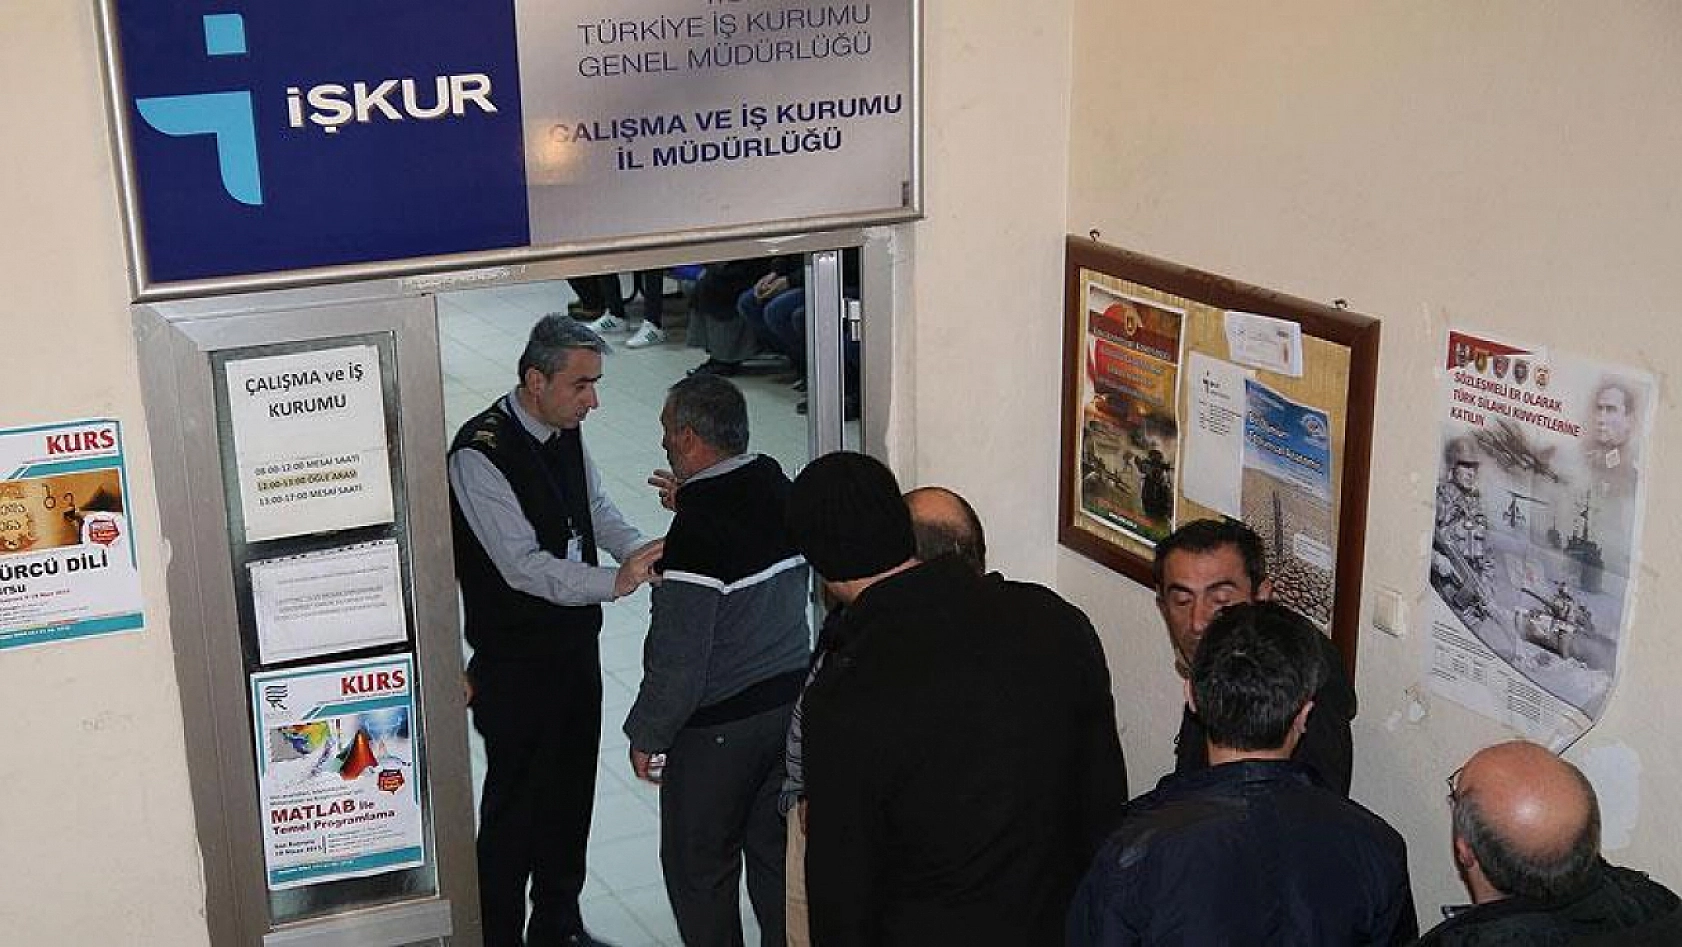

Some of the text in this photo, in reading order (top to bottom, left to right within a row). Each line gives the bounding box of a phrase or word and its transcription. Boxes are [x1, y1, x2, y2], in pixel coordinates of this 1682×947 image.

[577, 4, 871, 46] TÜRKİYE İŞ KURUMU
[578, 32, 871, 77] GENEL MÜDÜRLÜĞÜ
[286, 73, 498, 133] İŞKUR
[695, 108, 732, 132] VE
[742, 102, 768, 131] İŞ
[777, 94, 902, 123] KURUMU
[618, 129, 842, 171] İL MÜDÜRLÜĞÜ
[245, 362, 364, 396] ÇALIŞMA ve İŞ
[269, 393, 347, 418] KURUMU
[1524, 391, 1562, 411] OLARAK
[1450, 406, 1485, 427] KATILIN
[46, 429, 115, 455] KURS
[67, 549, 108, 573] DİLİ
[341, 670, 406, 696] KURS
[270, 799, 356, 824] MATLAB
[273, 810, 395, 836] Temel Programlama
